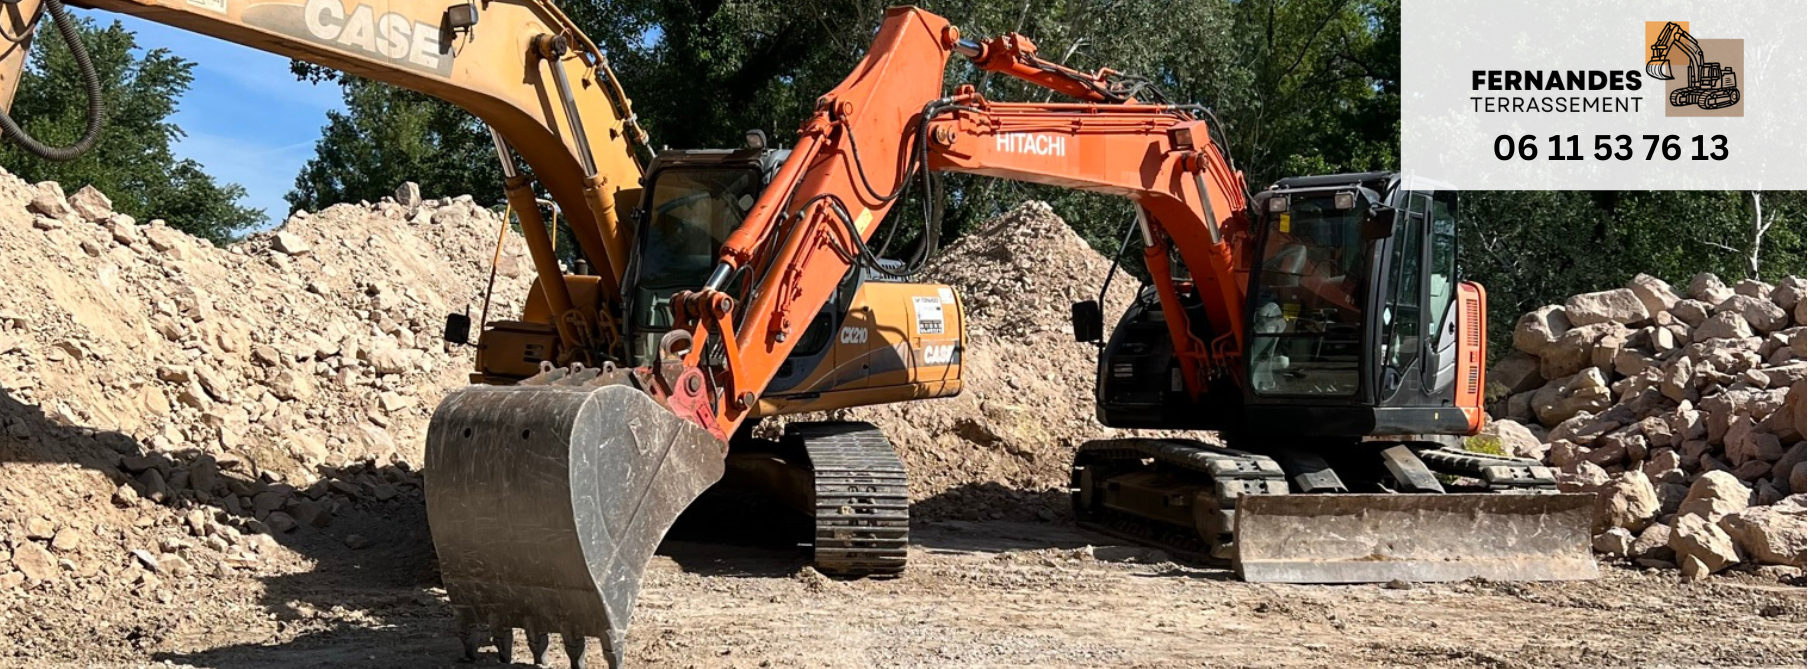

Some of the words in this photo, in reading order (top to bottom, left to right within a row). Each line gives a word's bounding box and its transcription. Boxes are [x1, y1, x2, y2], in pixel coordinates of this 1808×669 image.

[304, 0, 442, 69] CASE
[996, 132, 1066, 157] HITACHI
[840, 326, 869, 344] CX210
[924, 345, 956, 364] CASE
